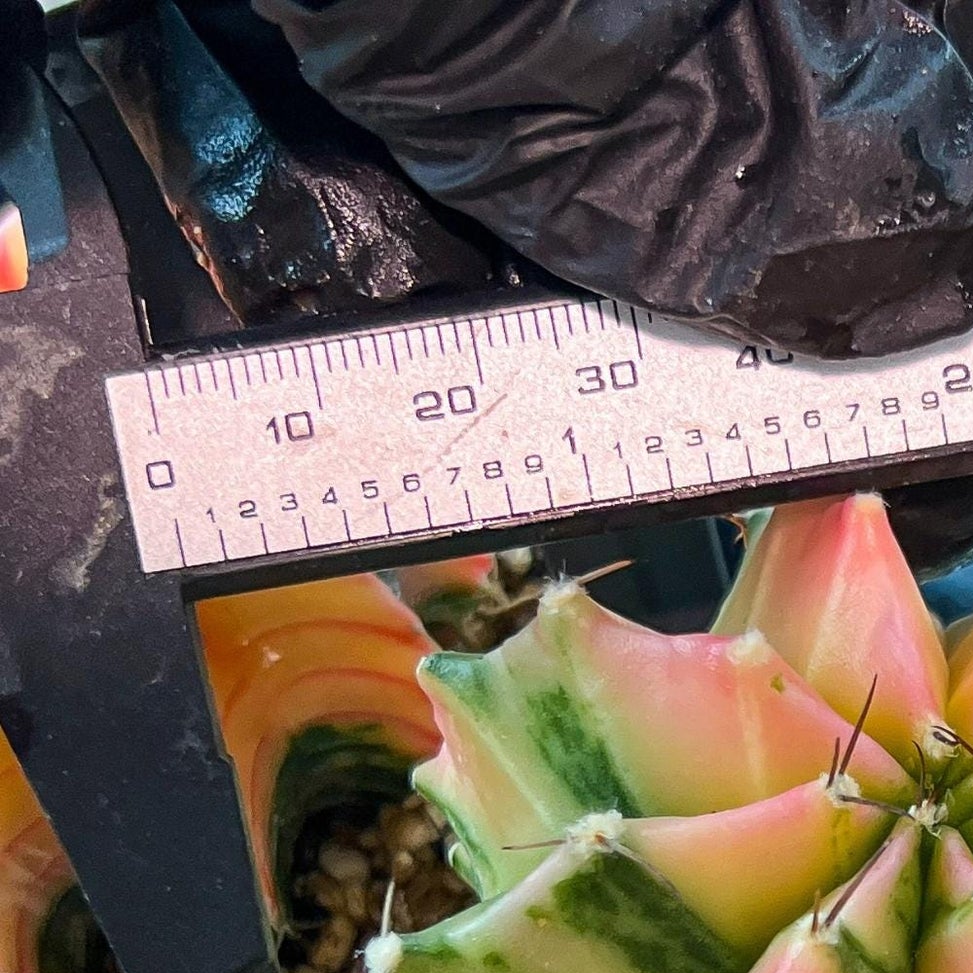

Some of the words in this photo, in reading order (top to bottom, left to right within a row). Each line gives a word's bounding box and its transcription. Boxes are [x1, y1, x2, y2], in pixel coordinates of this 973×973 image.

[145, 459, 176, 491] 0
[265, 410, 315, 445] 10
[412, 384, 476, 422] 20
[574, 359, 639, 396] 30
[205, 506, 216, 524] 1
[238, 499, 259, 519] 2
[279, 492, 299, 512] 3
[321, 486, 339, 505] 4
[360, 479, 380, 500] 5
[401, 472, 421, 493] 6
[445, 466, 462, 486] 7
[482, 459, 504, 480] 8
[523, 453, 544, 475] 9
[561, 426, 577, 455] 1
[612, 441, 623, 460] 1
[644, 435, 665, 455] 2
[684, 428, 704, 448] 3
[724, 422, 742, 441] 4
[763, 415, 782, 436] 5
[802, 409, 822, 430] 6
[845, 402, 861, 422] 7
[880, 396, 902, 416] 8
[920, 390, 940, 411] 9
[942, 363, 973, 395] 2
